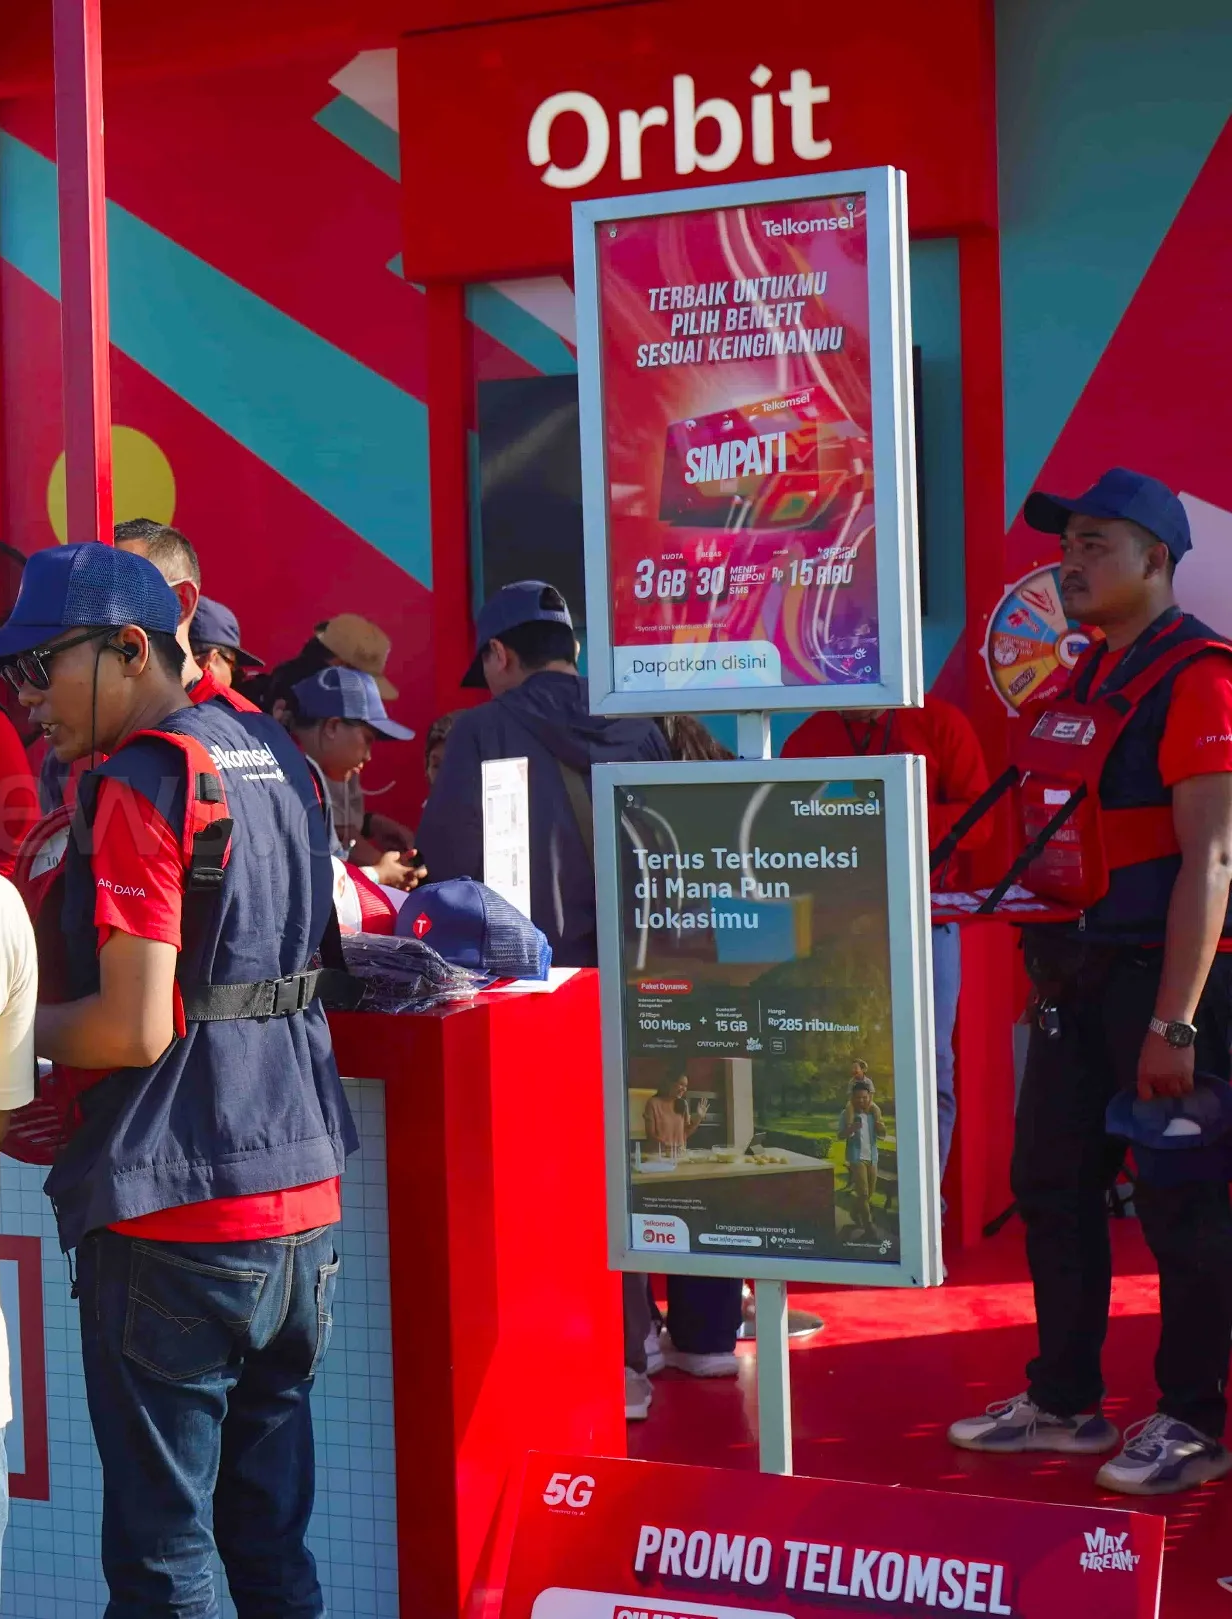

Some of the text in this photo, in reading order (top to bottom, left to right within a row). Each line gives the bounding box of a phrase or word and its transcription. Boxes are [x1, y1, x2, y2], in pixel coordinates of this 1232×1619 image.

[527, 63, 833, 189] Orbit
[762, 211, 854, 238] Telkomsel
[648, 271, 828, 312] TERBAIK UNTUKMU
[671, 301, 806, 337] PILIH BENEFIT
[636, 326, 844, 368] SESUAI KEINGINANMU
[761, 392, 811, 413] Telkomsel
[684, 431, 787, 485] SIMPATI
[661, 553, 684, 561] KUOTA
[634, 558, 687, 599] 3 GB
[696, 565, 726, 596] 30
[730, 565, 758, 574] MENIT
[730, 573, 766, 583] NELPON
[772, 559, 854, 587] Rp 15 RIBU
[729, 586, 749, 595] SMS
[632, 653, 767, 677] Dapatkan disini
[1206, 735, 1217, 743] PT
[208, 741, 280, 771] elkomsel
[790, 799, 880, 817] Telkomsel
[633, 846, 858, 870] Terus Terkoneksi
[97, 877, 146, 898] AR DAYA
[634, 877, 790, 899] di Mana Pun
[634, 907, 760, 929] Lokasimu
[641, 982, 688, 992] Paket Dynamic
[768, 1008, 786, 1016] Harga
[638, 1019, 660, 1030] 100
[661, 1019, 691, 1032] Mbps
[714, 1020, 728, 1032] 15
[729, 1020, 748, 1032] GB
[696, 1040, 740, 1048] CATCHPLAY+
[643, 1219, 676, 1228] Telkomsel
[715, 1223, 796, 1235] Langganan sekarang di
[643, 1228, 676, 1244] One
[777, 1236, 815, 1245] MyTelkomsel
[542, 1472, 596, 1508] 5G
[1083, 1526, 1129, 1555] MAX
[635, 1524, 1012, 1616] PROMO TELKOMSEL
[1079, 1549, 1134, 1574] STREAM
